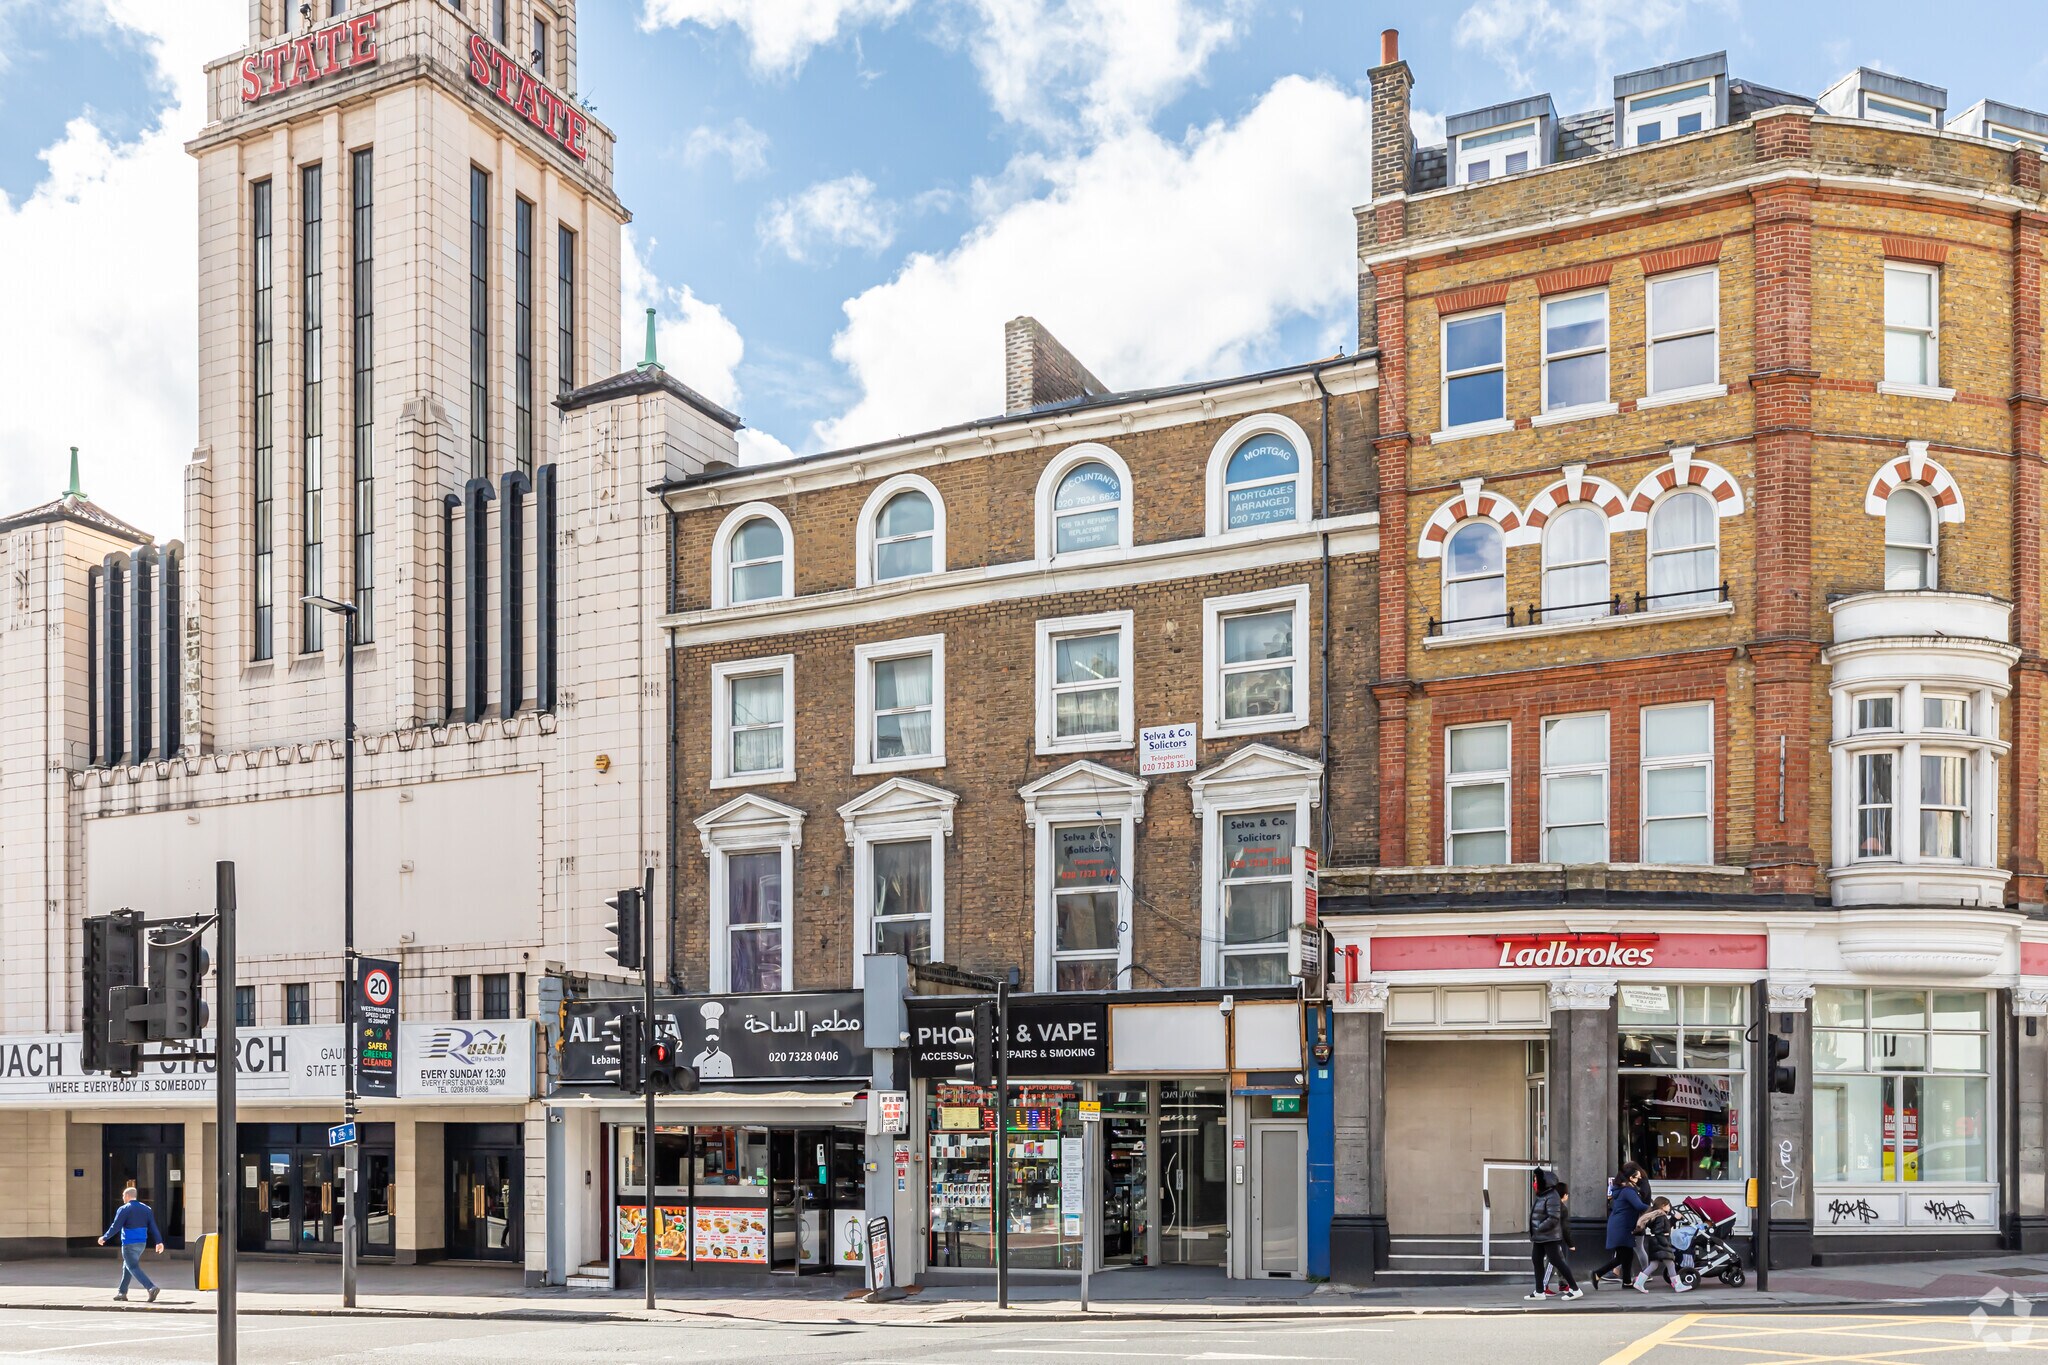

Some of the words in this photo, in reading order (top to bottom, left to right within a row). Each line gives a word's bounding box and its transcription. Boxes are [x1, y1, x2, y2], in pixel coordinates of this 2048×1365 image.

[242, 13, 376, 102] STATE
[469, 33, 588, 163] STATE
[1243, 446, 1291, 461] MORTGAG
[1059, 472, 1118, 497] ACCOUNTANTS
[1231, 485, 1293, 502] MORTGAGES
[1057, 499, 1073, 507] 020
[1235, 496, 1290, 512] ARRANGED
[1087, 514, 1116, 525] REFUNDS
[1231, 514, 1248, 524] 020
[1250, 511, 1271, 521] 7372
[1273, 507, 1294, 518] 3576
[1068, 524, 1107, 537] REPLACEMENT
[1143, 732, 1166, 741] Selva
[1168, 730, 1175, 739] &
[1178, 729, 1193, 737] Co.
[1142, 763, 1155, 771] 020
[1157, 761, 1175, 770] 7328
[1177, 759, 1194, 768] 3330
[1231, 821, 1255, 830] Selva
[1259, 819, 1267, 827] &
[1272, 817, 1288, 826] Co.
[1063, 833, 1086, 842] Selva
[1090, 832, 1096, 840] &
[1101, 831, 1116, 839] Co.
[1237, 833, 1281, 843] Solicitors
[1069, 845, 1109, 854] Solicitors
[1498, 941, 1655, 967] Ladbrokes
[370, 978, 387, 995] 20
[744, 1010, 807, 1033] الساحة
[811, 1009, 860, 1037] مطعم
[1016, 1024, 1032, 1043] &
[1037, 1022, 1097, 1042] VAPE
[367, 1042, 387, 1051] SAFER
[1040, 1050, 1047, 1058] &
[1049, 1048, 1096, 1058] SMOKING
[363, 1050, 392, 1059] GREENER
[768, 1052, 786, 1062] 020
[788, 1051, 813, 1062] 7328
[814, 1051, 839, 1061] 0406
[362, 1058, 392, 1067] CLEANER
[306, 1064, 337, 1077] STATE
[421, 1069, 448, 1079] EVERY
[449, 1069, 483, 1078] SUNDAY
[485, 1069, 506, 1078] 12:30
[49, 1082, 79, 1093] WHERE
[84, 1081, 137, 1093] EVERYBODY
[141, 1080, 150, 1091] IS
[154, 1079, 207, 1091] SOMEBODY
